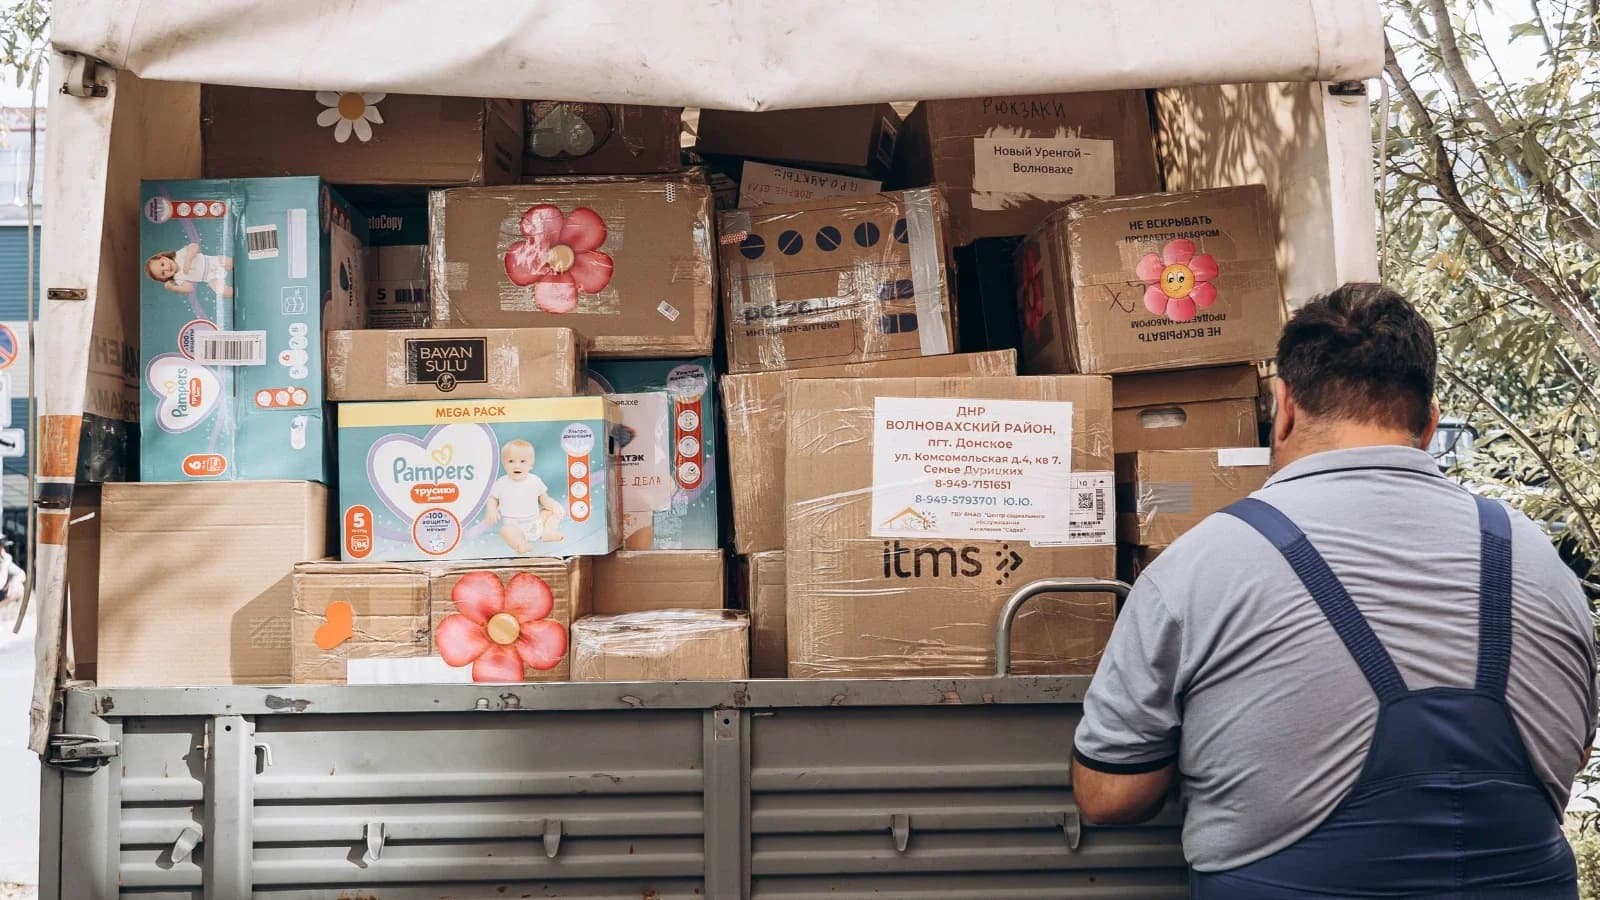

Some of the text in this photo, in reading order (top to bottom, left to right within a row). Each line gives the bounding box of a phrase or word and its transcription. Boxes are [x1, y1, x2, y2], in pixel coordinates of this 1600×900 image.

[994, 145, 1032, 157] Новый
[1034, 147, 1081, 159] Уренгой
[1013, 162, 1073, 174] Волновахе
[1129, 215, 1212, 231] НЕ ВСКРЫВАТЬ
[1177, 229, 1220, 239] НАБОРОМ
[1131, 317, 1174, 328] НАБОРОМ
[1138, 326, 1221, 342] НЕ ВСКРЫВАТЬ
[420, 346, 472, 359] BAYAN
[425, 360, 467, 372] SULU
[171, 368, 189, 417] Pampers
[435, 406, 506, 418] MEGA PACK
[956, 406, 986, 418] ДНР
[886, 420, 1056, 435] ВОЛНОВАХСКИЙ РАЙОН,
[928, 438, 1013, 449] пгт. Донское
[894, 453, 911, 463] ул.
[915, 452, 1008, 464] Комсомольская
[1011, 455, 1032, 465] д.4,
[1052, 456, 1062, 465] 7.
[188, 460, 202, 470] 6
[393, 457, 474, 484] Pampers
[923, 464, 1024, 476] Семье Дурицких
[935, 479, 1011, 490] 8-949-7151651
[414, 487, 456, 497] трусики
[915, 495, 1033, 506] 8-949-5793701 Ю.Ю.
[353, 512, 365, 528] 5
[883, 540, 982, 578] itms
